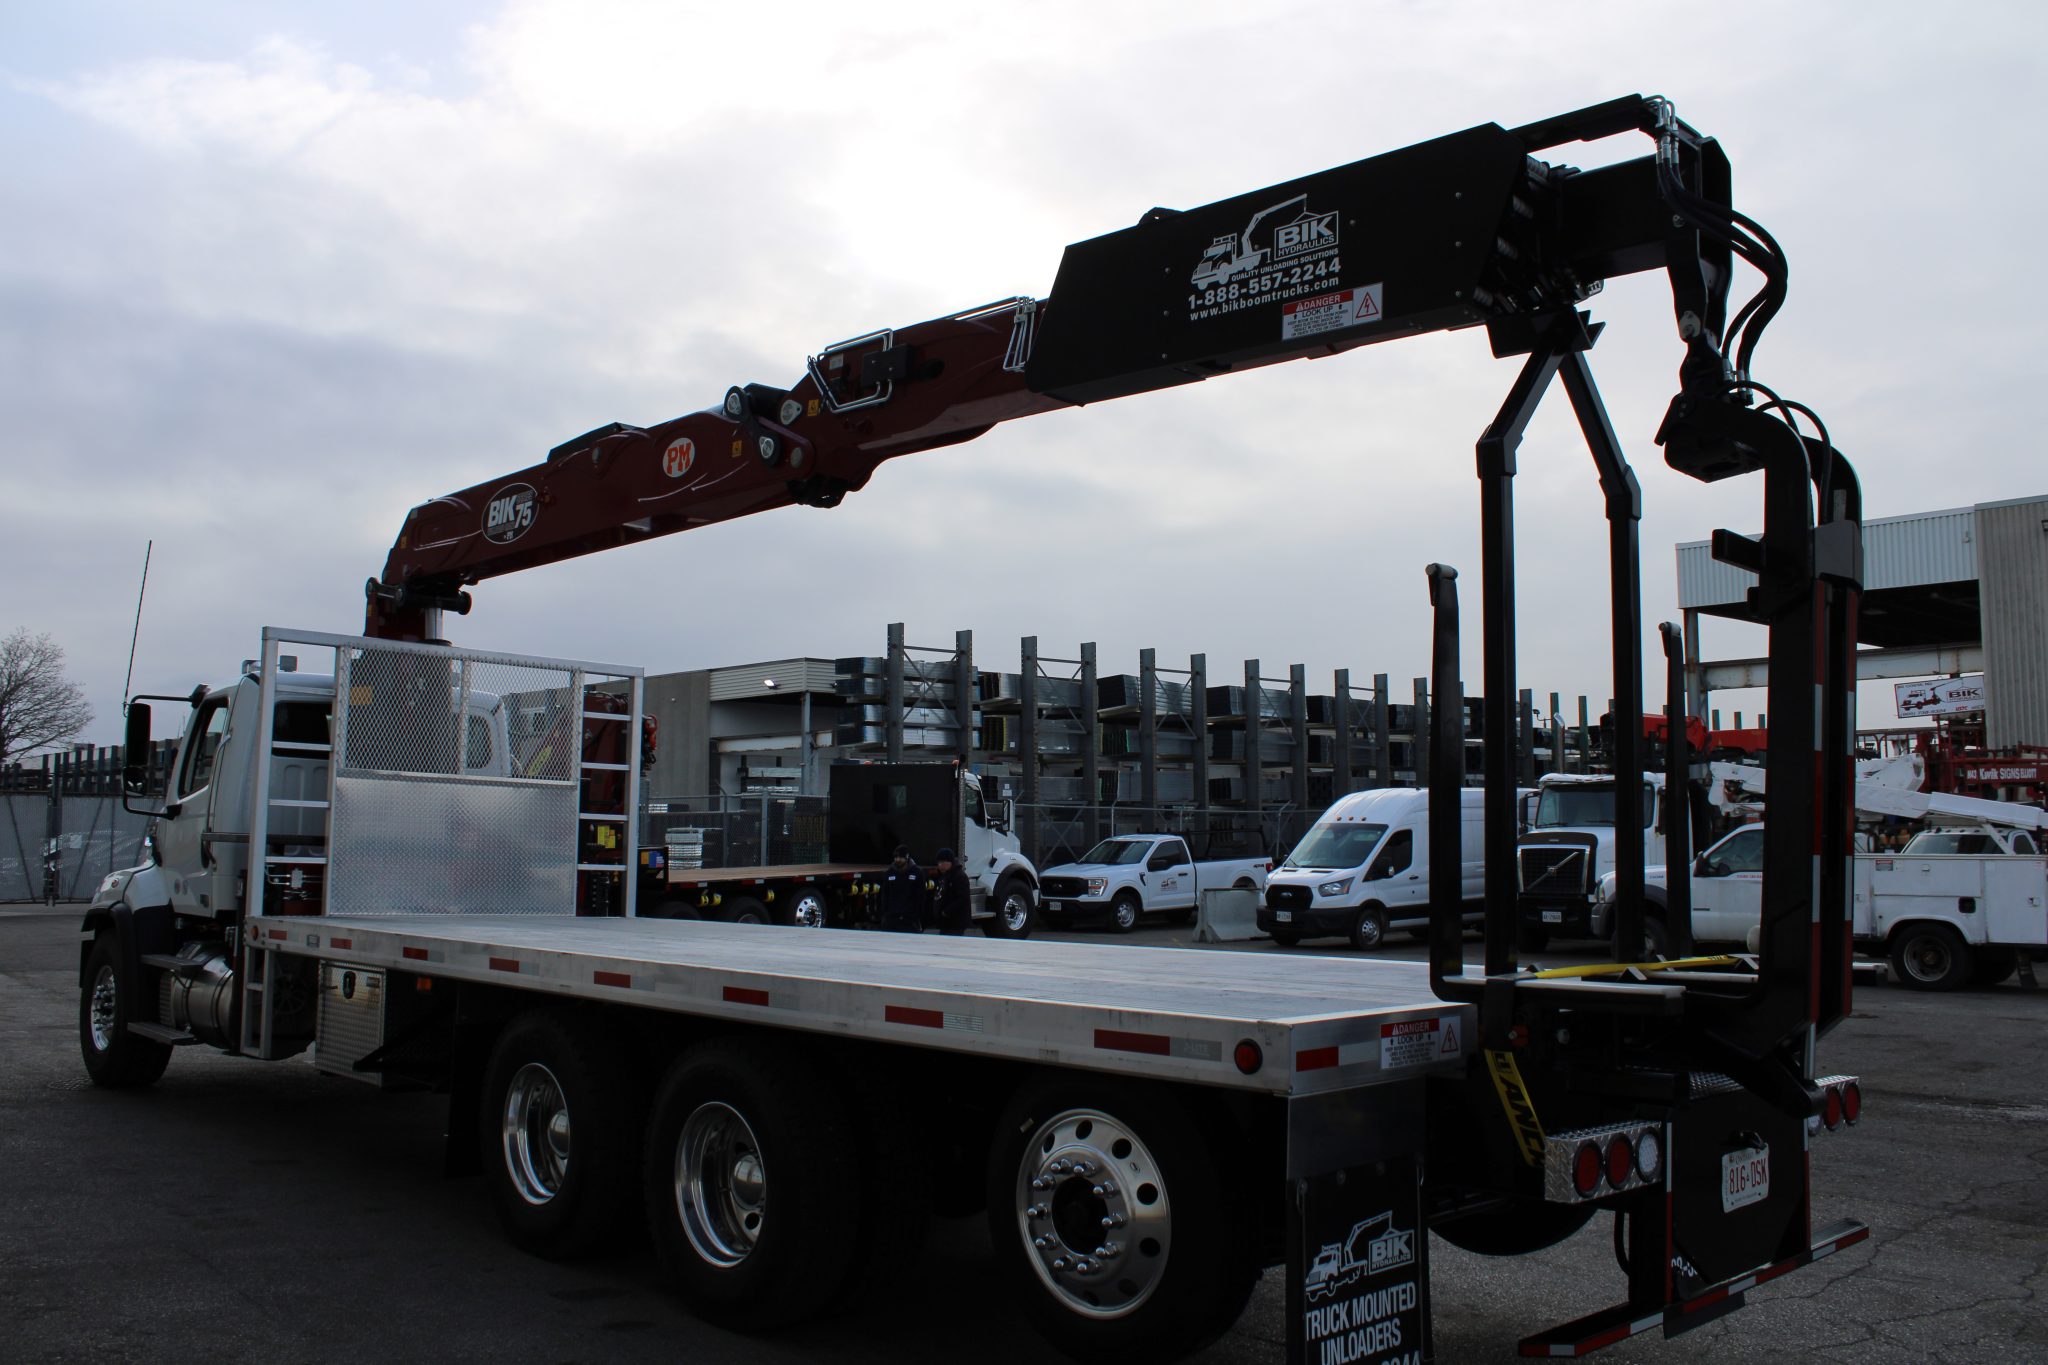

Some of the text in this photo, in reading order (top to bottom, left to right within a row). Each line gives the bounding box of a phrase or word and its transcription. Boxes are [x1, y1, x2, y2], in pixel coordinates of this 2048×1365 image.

[1278, 215, 1335, 249] BIK
[1278, 235, 1335, 257] HYDRAULICS
[1231, 248, 1339, 282] QUALITY UNLOADING SOLUTIONS
[1188, 257, 1342, 310] 1-888-557-2244
[1190, 276, 1340, 321] www.bikboomtrucks.com
[1301, 308, 1321, 318] LOOK
[1323, 305, 1334, 314] UP
[1303, 294, 1342, 310] DANGER
[667, 441, 691, 474] PM
[487, 494, 518, 528] BIK
[514, 500, 533, 529] 75
[1949, 689, 1980, 698] BIK
[1999, 767, 2020, 780] SIGNS
[1397, 1033, 1424, 1045] LOOK UP
[1399, 1022, 1430, 1035] DANGER
[1729, 1165, 1746, 1195] 816
[1751, 1158, 1768, 1188] DSK
[1371, 1234, 1412, 1262] BIK
[1371, 1253, 1412, 1270] HYDRAULICS
[1306, 1281, 1417, 1342] TRUCK MOUNTED
[1320, 1316, 1402, 1365] UNLOADERS
